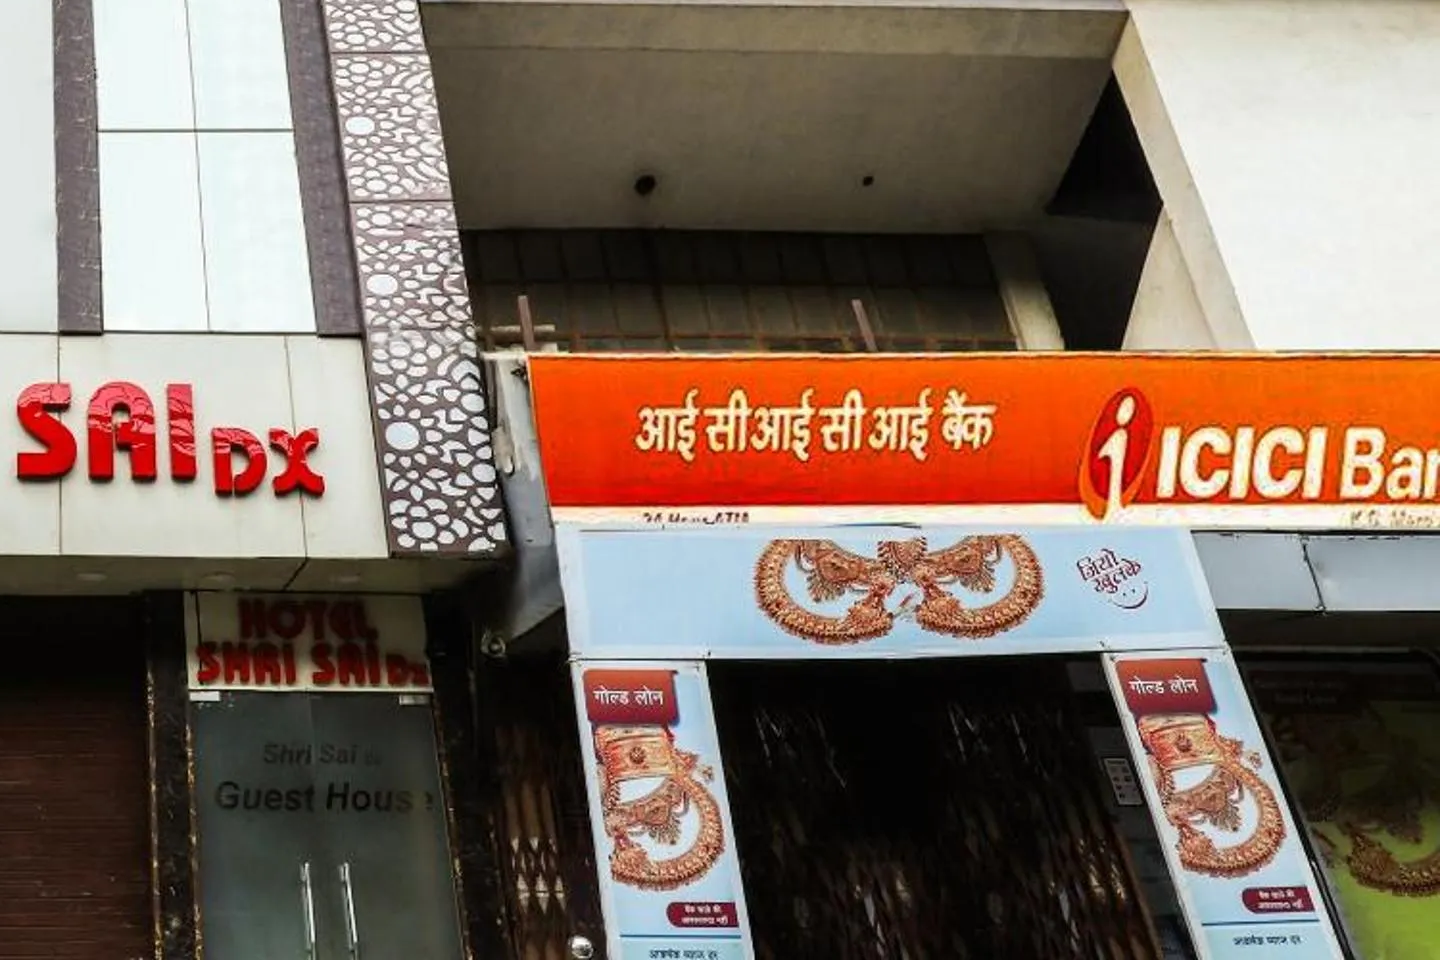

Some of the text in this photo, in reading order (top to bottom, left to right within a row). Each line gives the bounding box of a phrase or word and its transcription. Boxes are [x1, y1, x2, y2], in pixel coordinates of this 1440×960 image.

[16, 380, 199, 484] SAI
[1156, 425, 1328, 499] ICICI
[237, 597, 379, 641] HOTEL
[196, 640, 297, 685] SHRI
[311, 641, 381, 686] SAI
[592, 685, 664, 706] गोल्ड लोन
[1168, 675, 1199, 694] लोन
[263, 743, 313, 765] Shri
[319, 743, 357, 766] Sai
[216, 780, 315, 813] Guest
